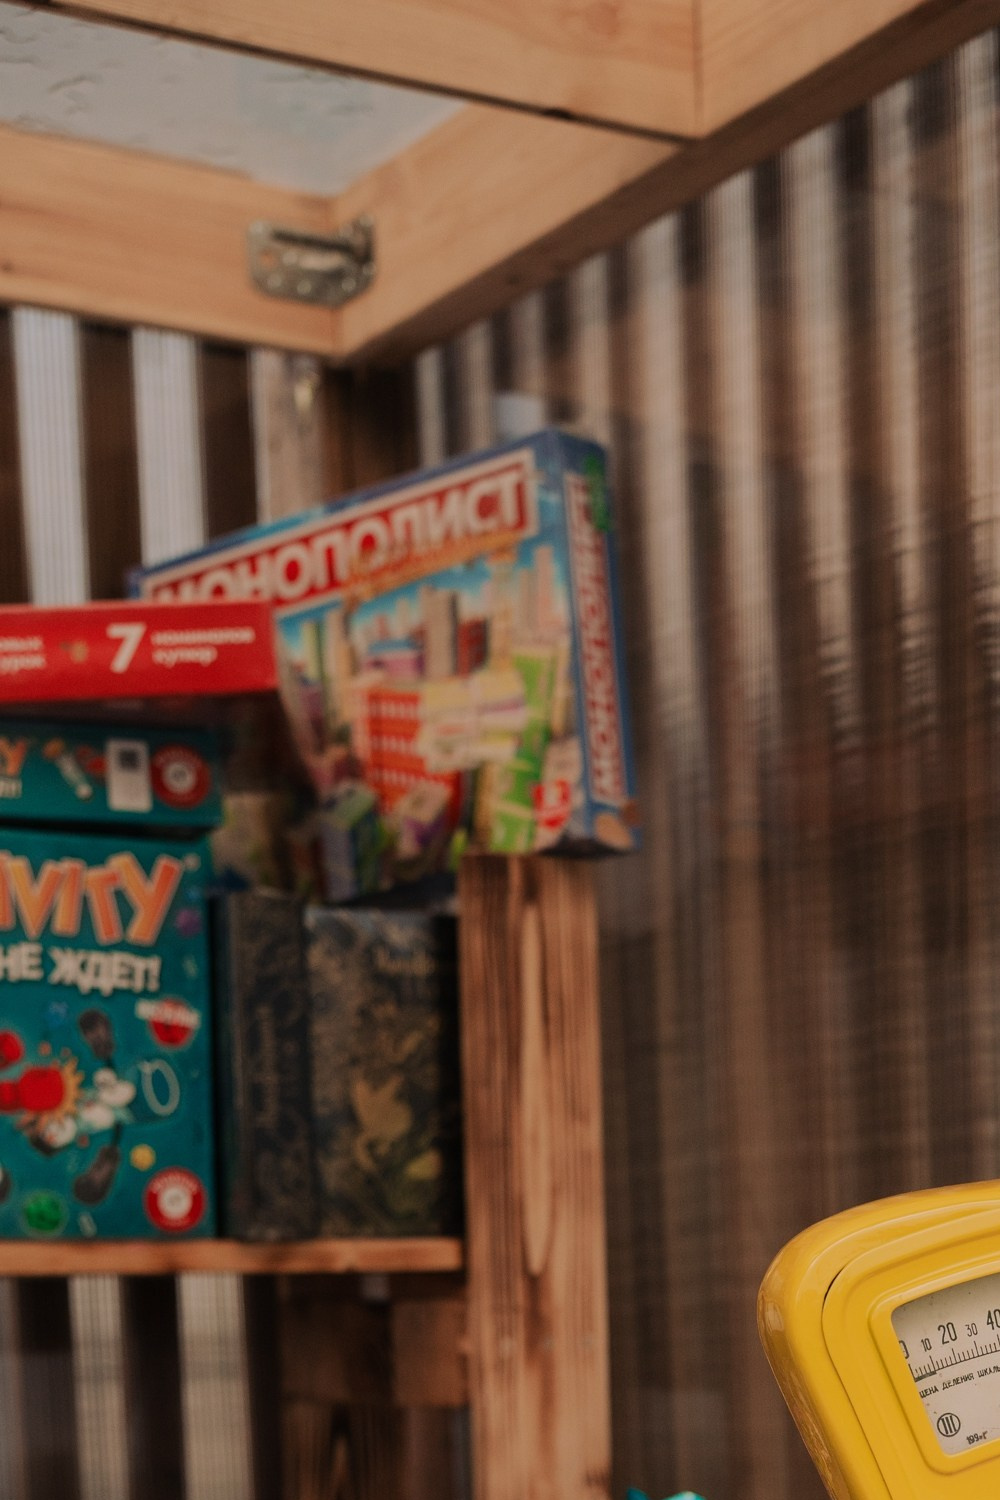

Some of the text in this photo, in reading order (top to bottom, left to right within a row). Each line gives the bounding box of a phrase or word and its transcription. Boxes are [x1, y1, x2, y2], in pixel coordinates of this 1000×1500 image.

[106, 621, 147, 674] 7
[48, 946, 162, 996] ЖДЕТ!
[921, 1338, 932, 1352] 10
[937, 1322, 958, 1345] 20
[965, 1323, 978, 1337] 30
[919, 1384, 939, 1399] ЦЕНА
[942, 1372, 975, 1391] ДЕЛЕНИЯ
